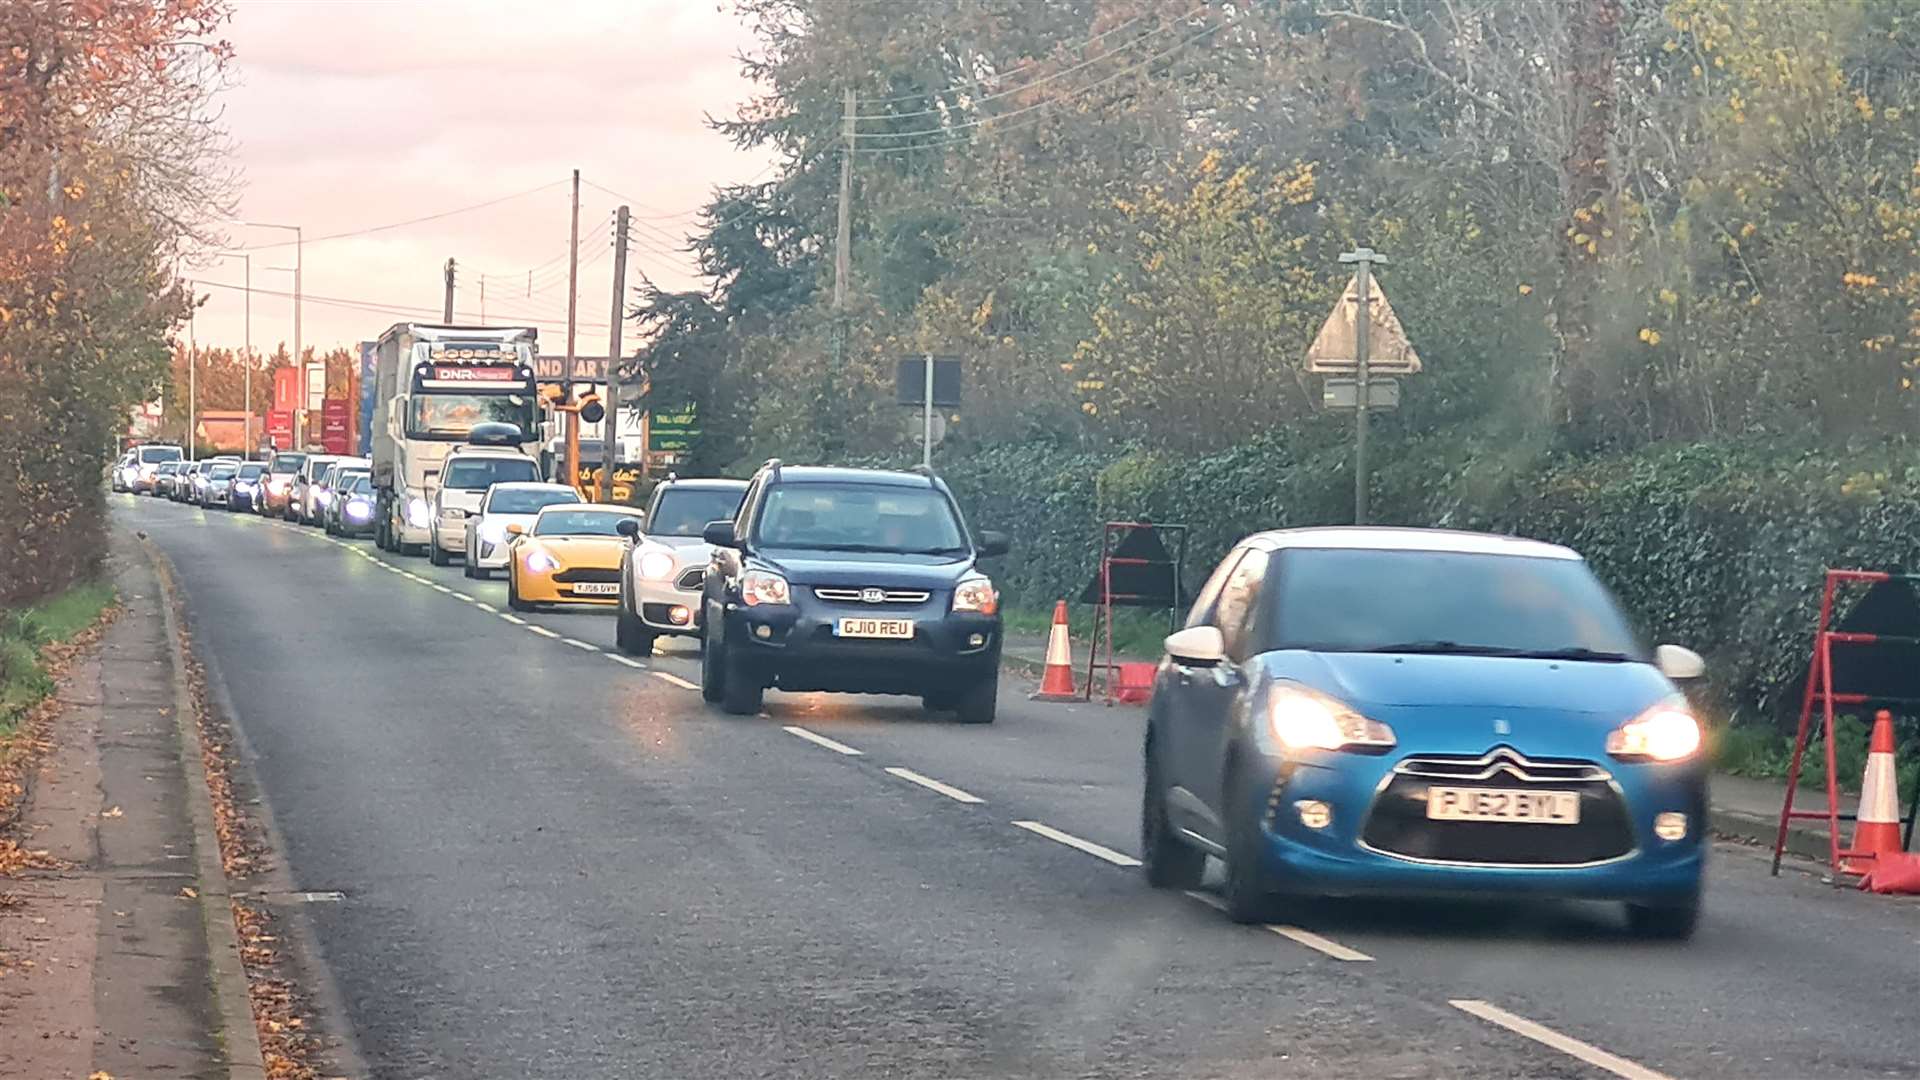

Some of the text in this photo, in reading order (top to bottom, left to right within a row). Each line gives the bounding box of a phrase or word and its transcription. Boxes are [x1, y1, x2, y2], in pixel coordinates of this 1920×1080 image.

[440, 370, 472, 379] DNR
[844, 621, 907, 634] GJ10 REU
